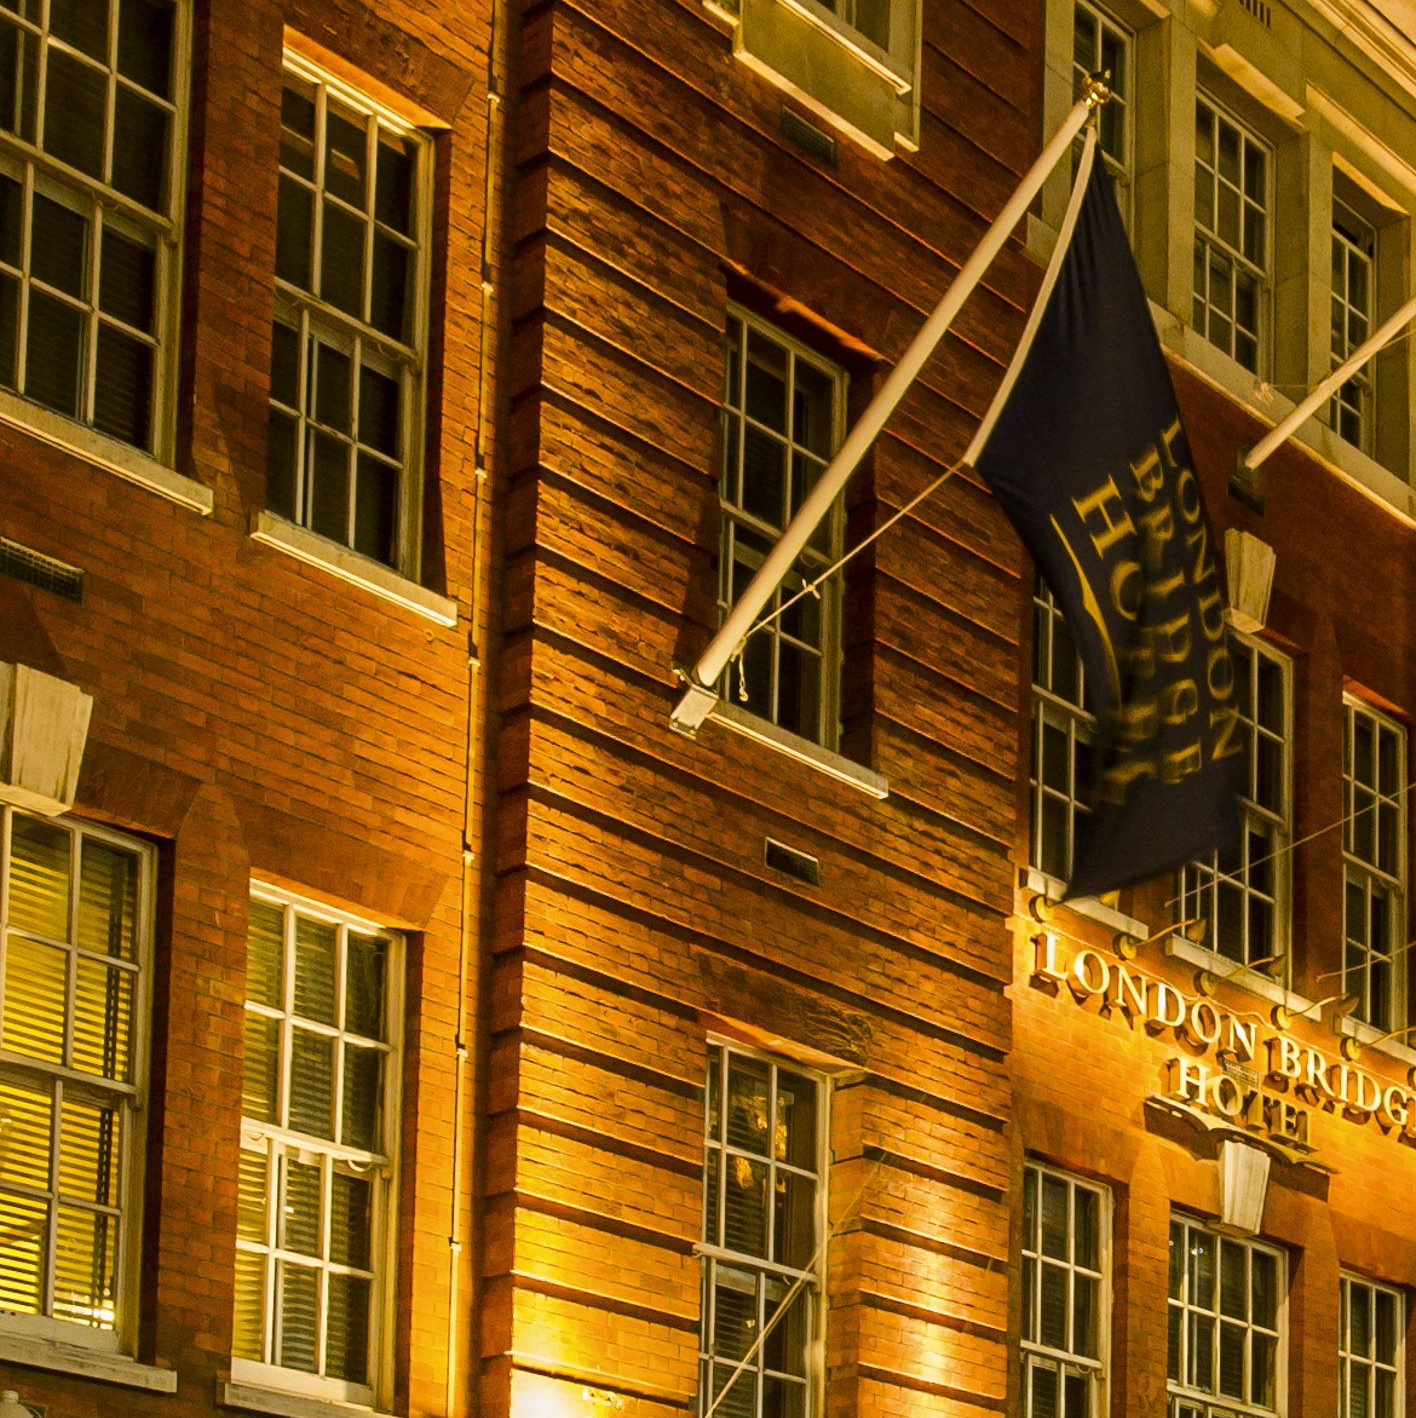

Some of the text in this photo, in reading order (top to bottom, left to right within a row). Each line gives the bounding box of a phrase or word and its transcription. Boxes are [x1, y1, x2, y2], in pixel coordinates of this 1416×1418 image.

[1129, 441, 1207, 786] BRIDGE
[1161, 416, 1243, 763] LONDON
[1041, 931, 1258, 1062] LONDON
[1175, 1057, 1316, 1147] HOTEL
